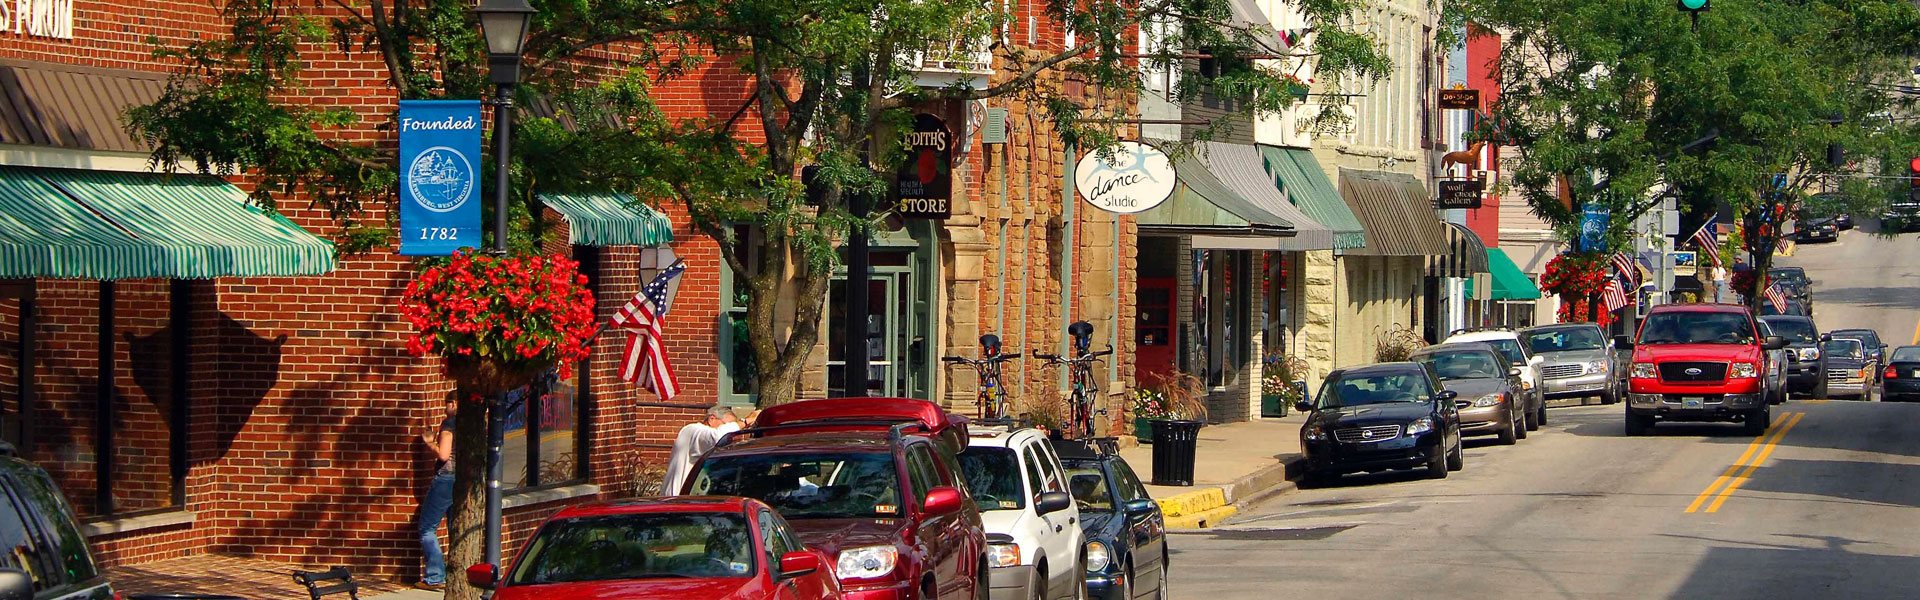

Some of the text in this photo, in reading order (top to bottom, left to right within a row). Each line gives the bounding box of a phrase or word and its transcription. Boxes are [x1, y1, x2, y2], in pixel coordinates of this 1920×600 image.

[15, 0, 73, 39] FORUM
[402, 116, 477, 133] Founded
[903, 128, 946, 151] EDITH'S
[1090, 173, 1149, 201] dance
[437, 201, 454, 209] WEST
[900, 198, 947, 213] STORE
[1104, 195, 1138, 208] studio
[420, 227, 458, 240] 1782
